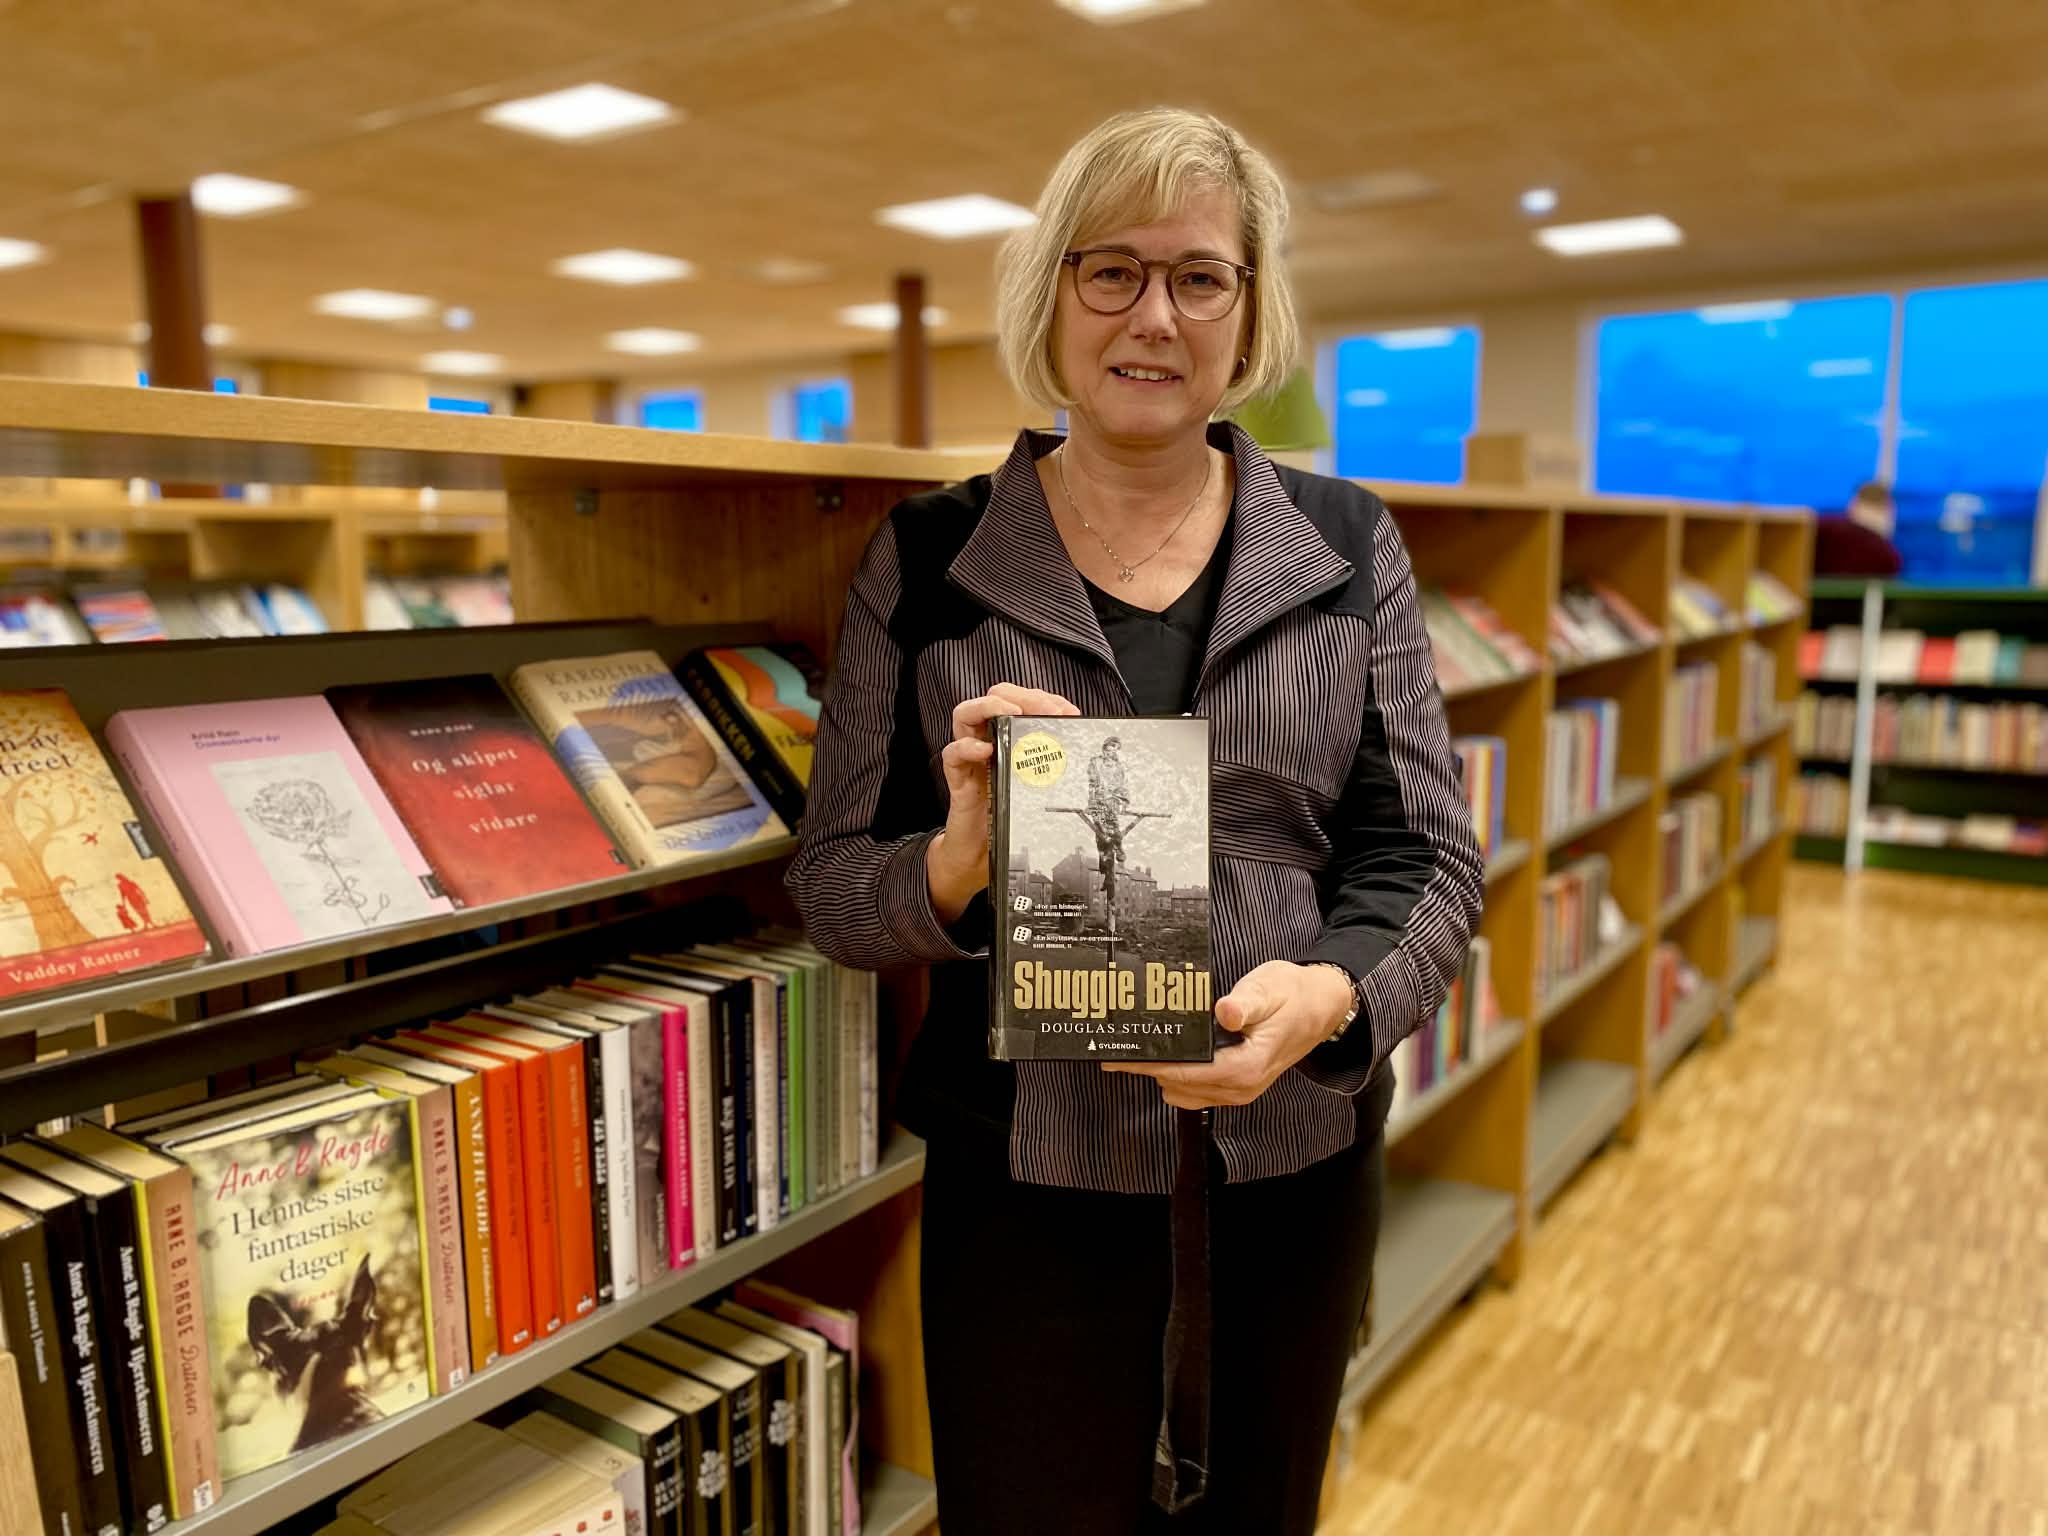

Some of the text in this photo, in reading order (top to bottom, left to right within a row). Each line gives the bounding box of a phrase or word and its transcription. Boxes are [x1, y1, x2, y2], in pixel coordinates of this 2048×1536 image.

[412, 749, 518, 775] Og skipet
[453, 781, 515, 800] siglar
[468, 813, 539, 833] vidare
[8, 948, 140, 984] Vaddey Ratner
[1014, 960, 1210, 1019] Shuggie Bain
[1041, 1022, 1185, 1035] DOUGLAS STUART
[1098, 1042, 1141, 1050] GYLDENDAL
[432, 1118, 446, 1160] ANNE
[469, 1090, 486, 1147] ANNE
[217, 1160, 289, 1201] Anne
[320, 1124, 392, 1170] Ragde
[165, 1203, 185, 1252] ANNE
[232, 1176, 385, 1235] Hennes siste
[437, 1184, 452, 1235] RAGDE
[473, 1168, 490, 1241] RAGDE
[248, 1209, 374, 1263] fantastiske
[67, 1261, 82, 1299] Anne
[120, 1246, 134, 1281] Anne
[279, 1248, 350, 1283] dager
[123, 1297, 144, 1341] Ragde
[172, 1279, 194, 1338] RAGDE
[73, 1315, 92, 1358] Ragde
[127, 1345, 154, 1457] Hjerteknuseren
[179, 1344, 198, 1415] Datteren
[76, 1362, 104, 1475] Hjerteknuseren
